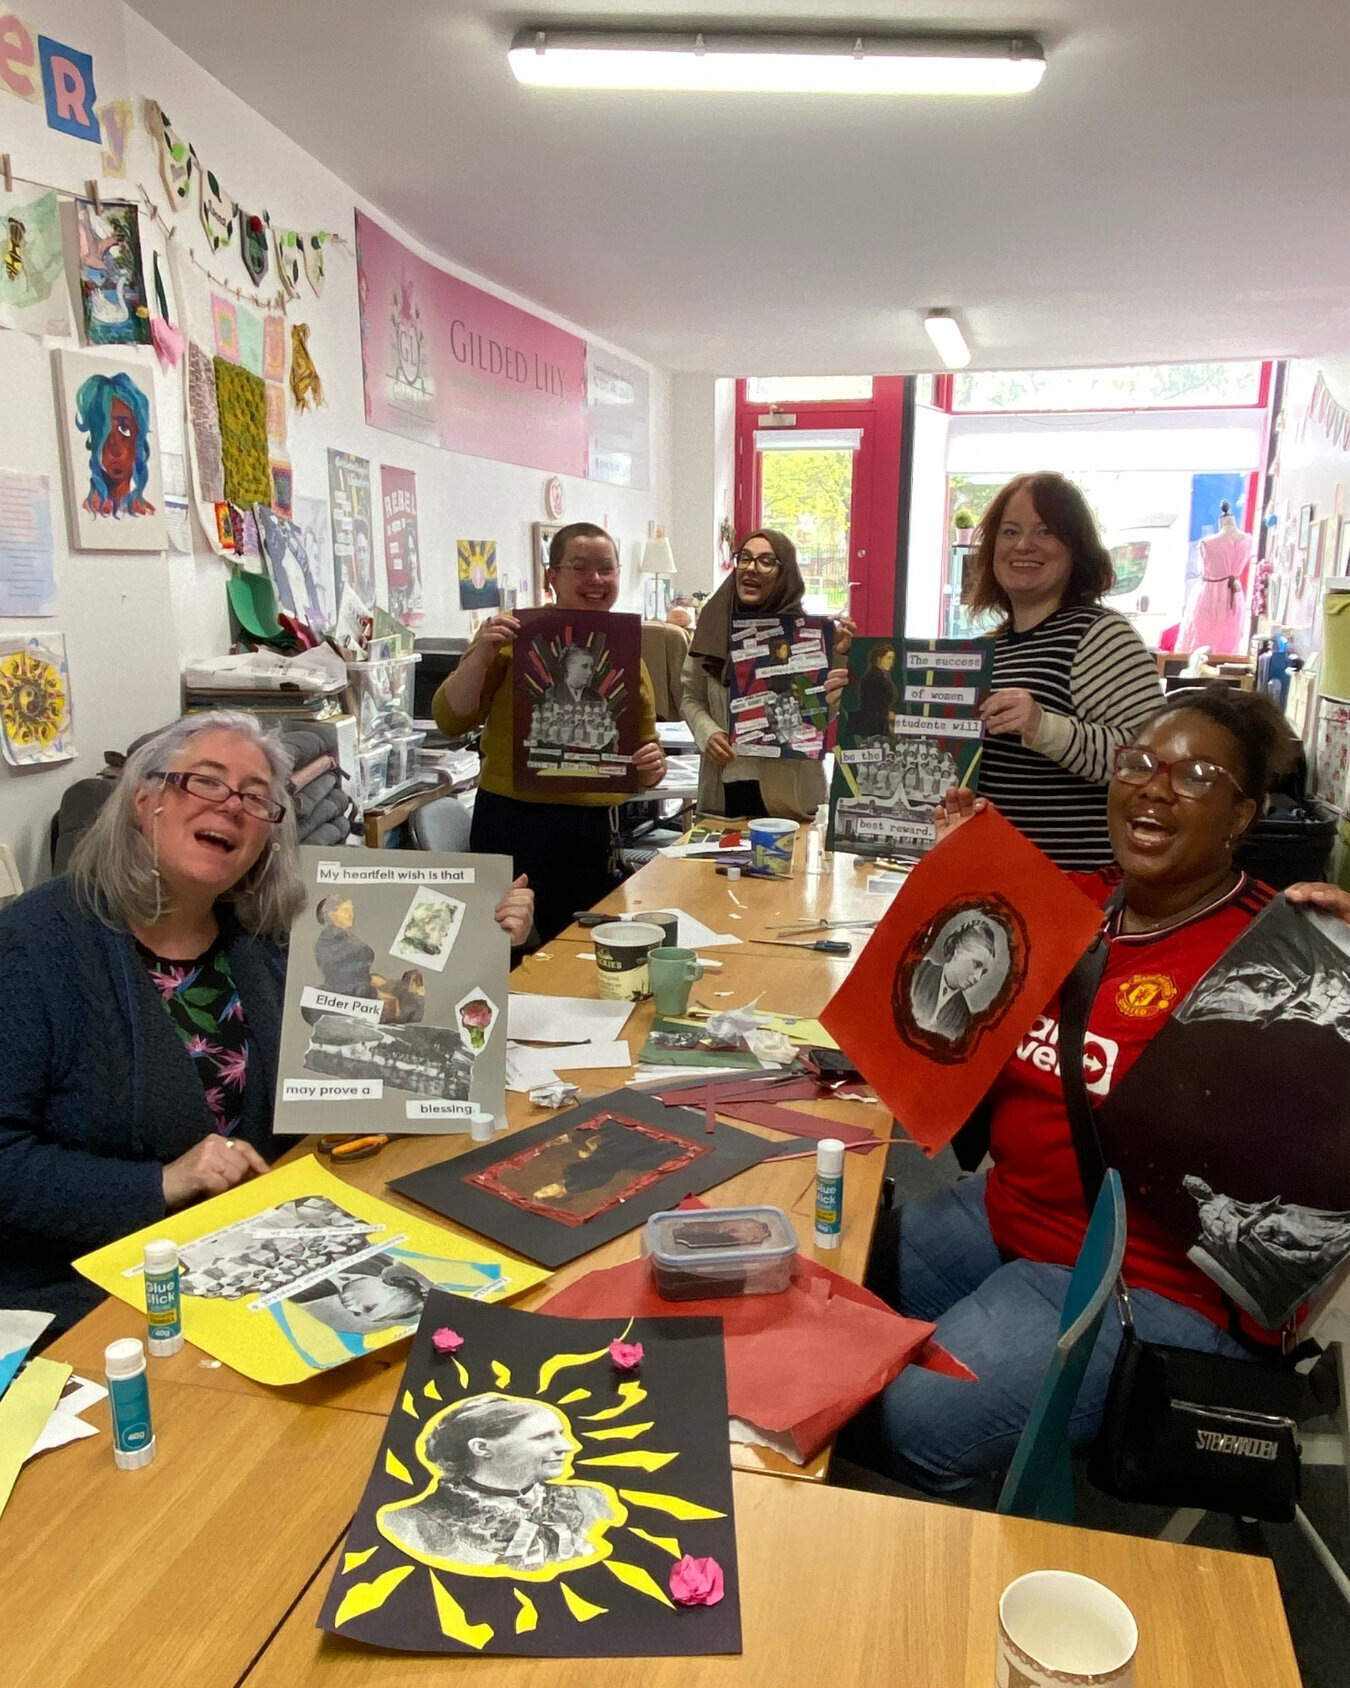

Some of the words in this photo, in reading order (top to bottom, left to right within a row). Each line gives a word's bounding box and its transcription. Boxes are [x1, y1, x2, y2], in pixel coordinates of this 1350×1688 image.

[450, 319, 528, 384] GILDED
[535, 352, 567, 398] LILY
[384, 490, 416, 518] REBEL
[909, 655, 929, 666] The
[935, 657, 981, 668] success
[911, 689, 924, 699] of
[931, 691, 964, 702] women
[895, 718, 946, 731] students
[953, 721, 979, 732] will
[842, 751, 856, 762] be
[862, 750, 880, 761] the
[860, 818, 884, 831] best
[890, 823, 933, 837] reward.
[319, 868, 340, 882] My
[343, 868, 395, 880] heartfelt
[398, 869, 425, 880] wish
[429, 870, 439, 880] is
[441, 870, 465, 880] that
[316, 994, 348, 1012] Elder
[352, 1000, 381, 1016] Park
[286, 1085, 316, 1098] may
[319, 1085, 358, 1098] prove
[362, 1085, 371, 1095] a
